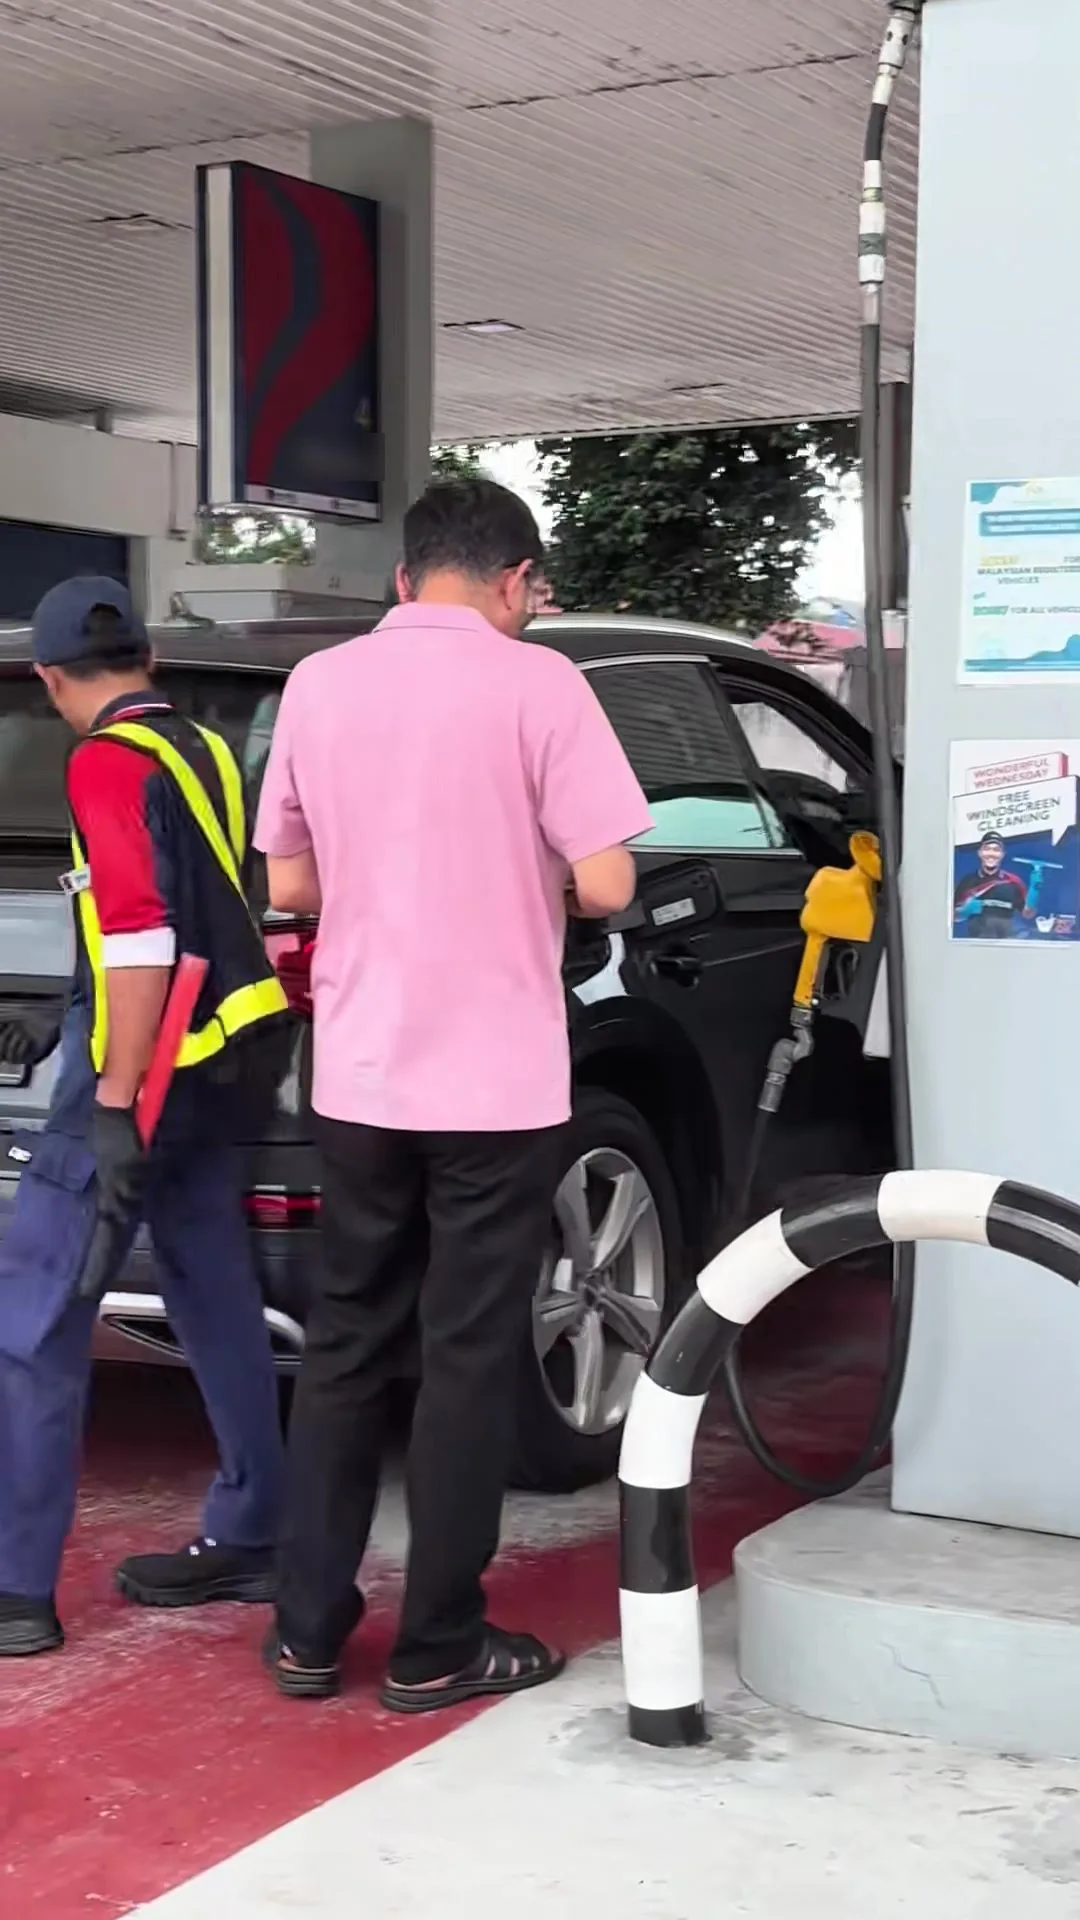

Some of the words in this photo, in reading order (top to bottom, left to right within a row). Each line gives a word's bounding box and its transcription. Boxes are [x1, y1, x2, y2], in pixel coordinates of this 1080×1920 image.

[977, 567, 1032, 575] MALAYSIAN
[998, 576, 1039, 584] VEHICLES
[973, 758, 1049, 779] WONDERFUL
[973, 769, 1048, 788] WEDNESDAY
[997, 790, 1031, 804] FREE
[966, 796, 1061, 821] WINDSCREEN
[977, 810, 1050, 831] CLEANING
